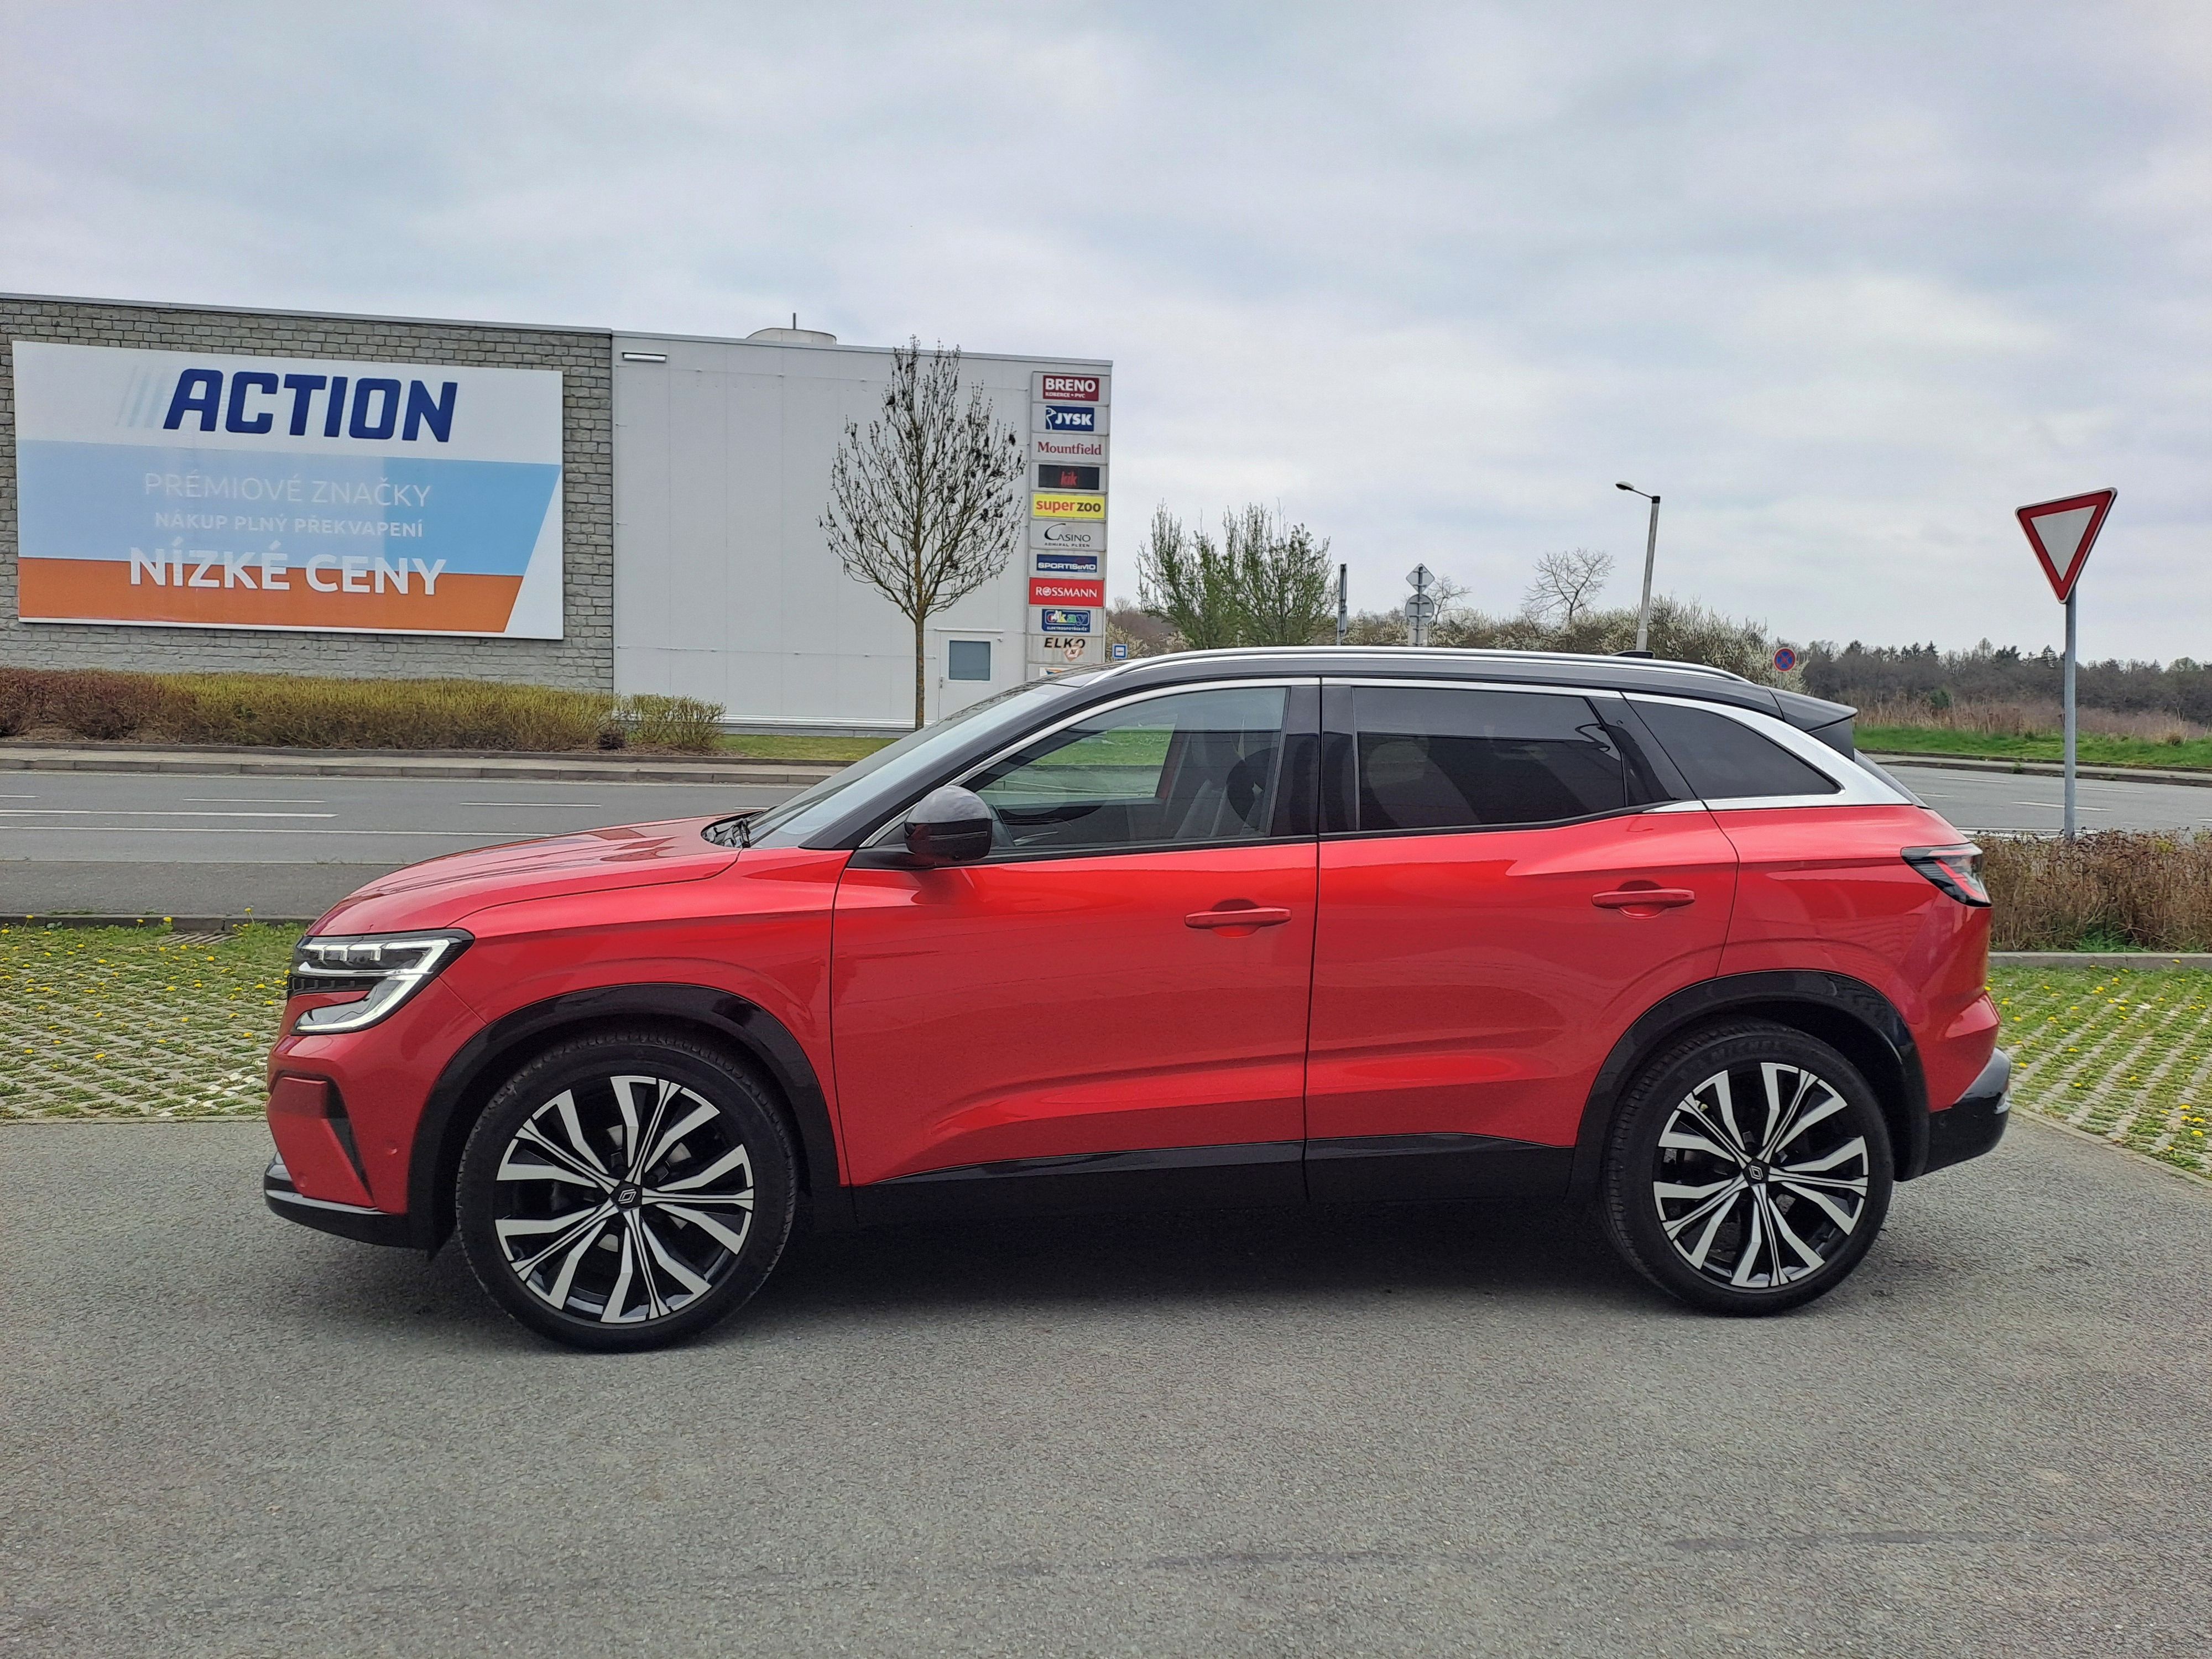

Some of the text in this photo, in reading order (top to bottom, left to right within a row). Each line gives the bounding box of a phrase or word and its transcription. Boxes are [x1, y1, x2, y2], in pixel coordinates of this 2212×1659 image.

[1045, 378, 1096, 392] BRENO
[163, 368, 457, 442] ACTION
[1055, 413, 1092, 425] JYSK
[1037, 442, 1102, 455] Mountfield
[145, 469, 431, 507] PRÉMIOVÉ ZNAČKY
[155, 509, 423, 537] NÁKUP PLNÝ PŘEKVAPENÍ
[1045, 523, 1091, 542] CASINO
[130, 536, 447, 595] NÍZKÉ CENY
[1036, 586, 1097, 597] ROSSMANN
